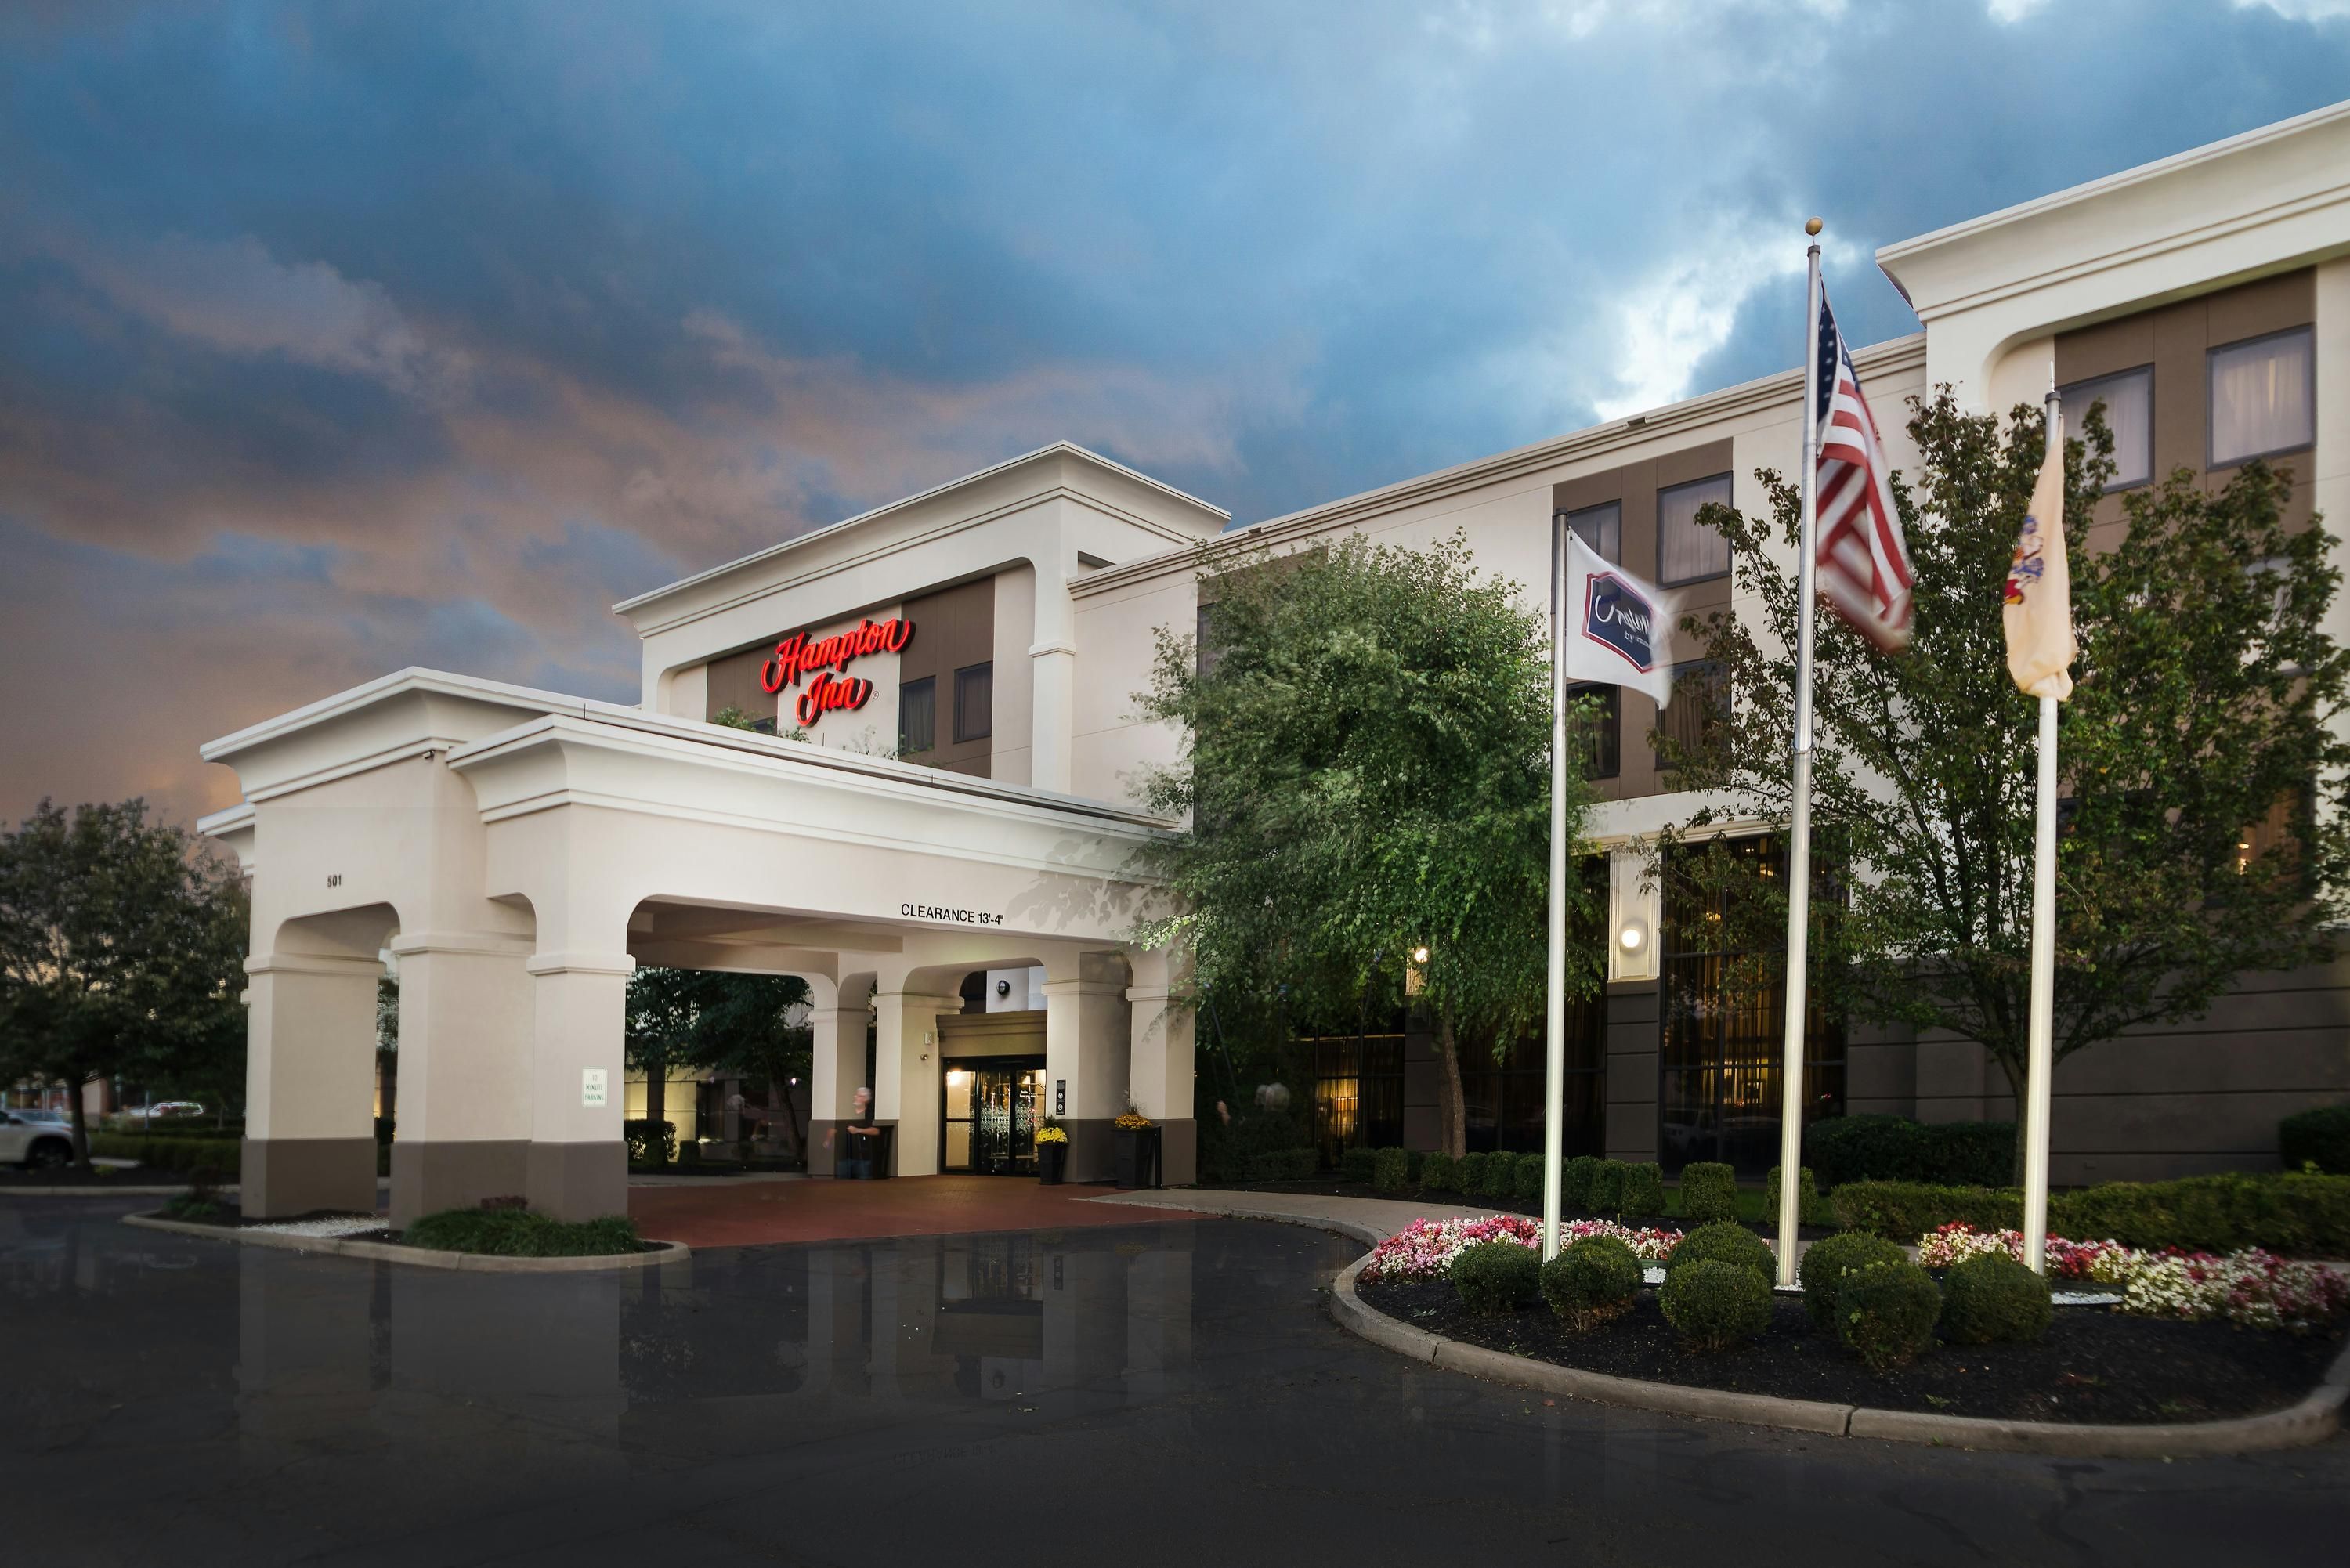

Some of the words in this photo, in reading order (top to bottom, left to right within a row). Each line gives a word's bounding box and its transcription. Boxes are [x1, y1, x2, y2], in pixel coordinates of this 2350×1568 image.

[761, 617, 916, 693] Hampton
[796, 671, 873, 727] Inn
[327, 874, 342, 887] 501
[901, 903, 975, 923] CLEARANCE
